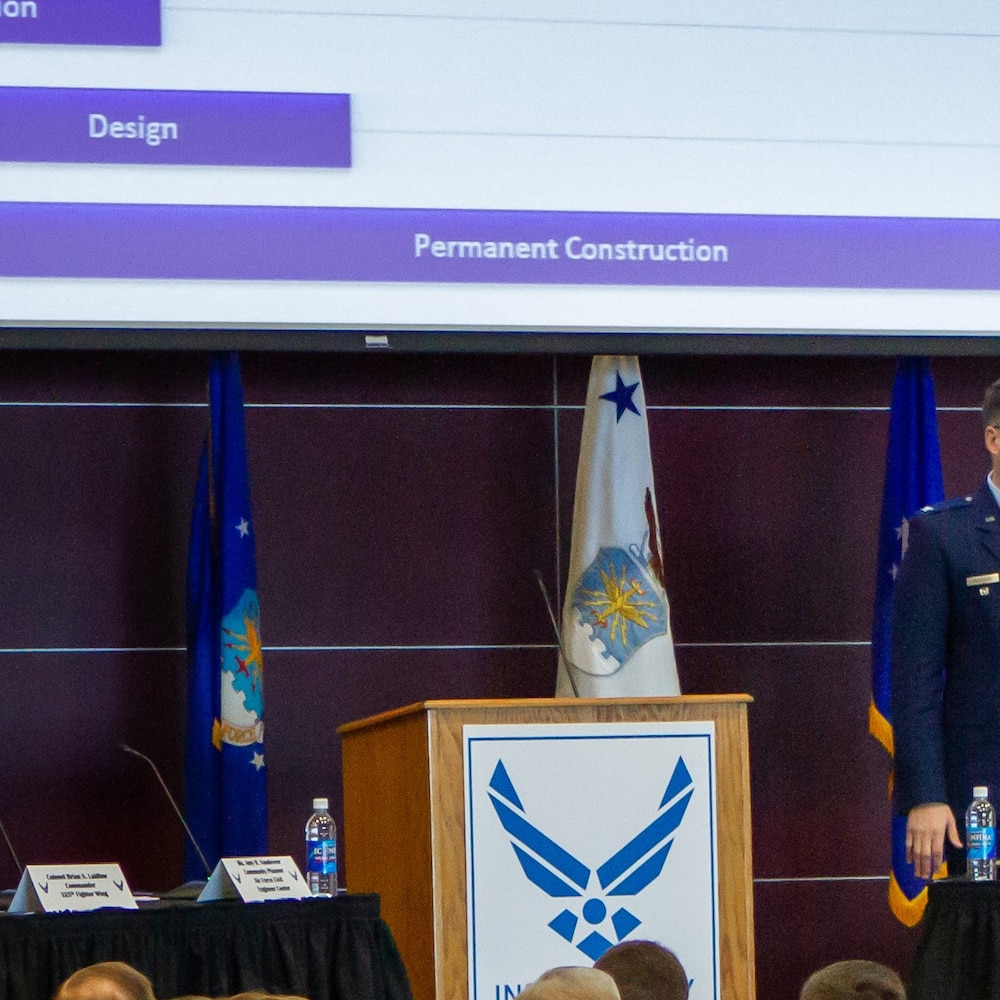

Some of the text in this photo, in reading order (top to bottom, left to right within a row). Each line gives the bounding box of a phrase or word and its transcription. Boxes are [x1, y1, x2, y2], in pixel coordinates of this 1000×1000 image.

[89, 113, 178, 146] Design
[414, 233, 729, 262] Permanent Construction
